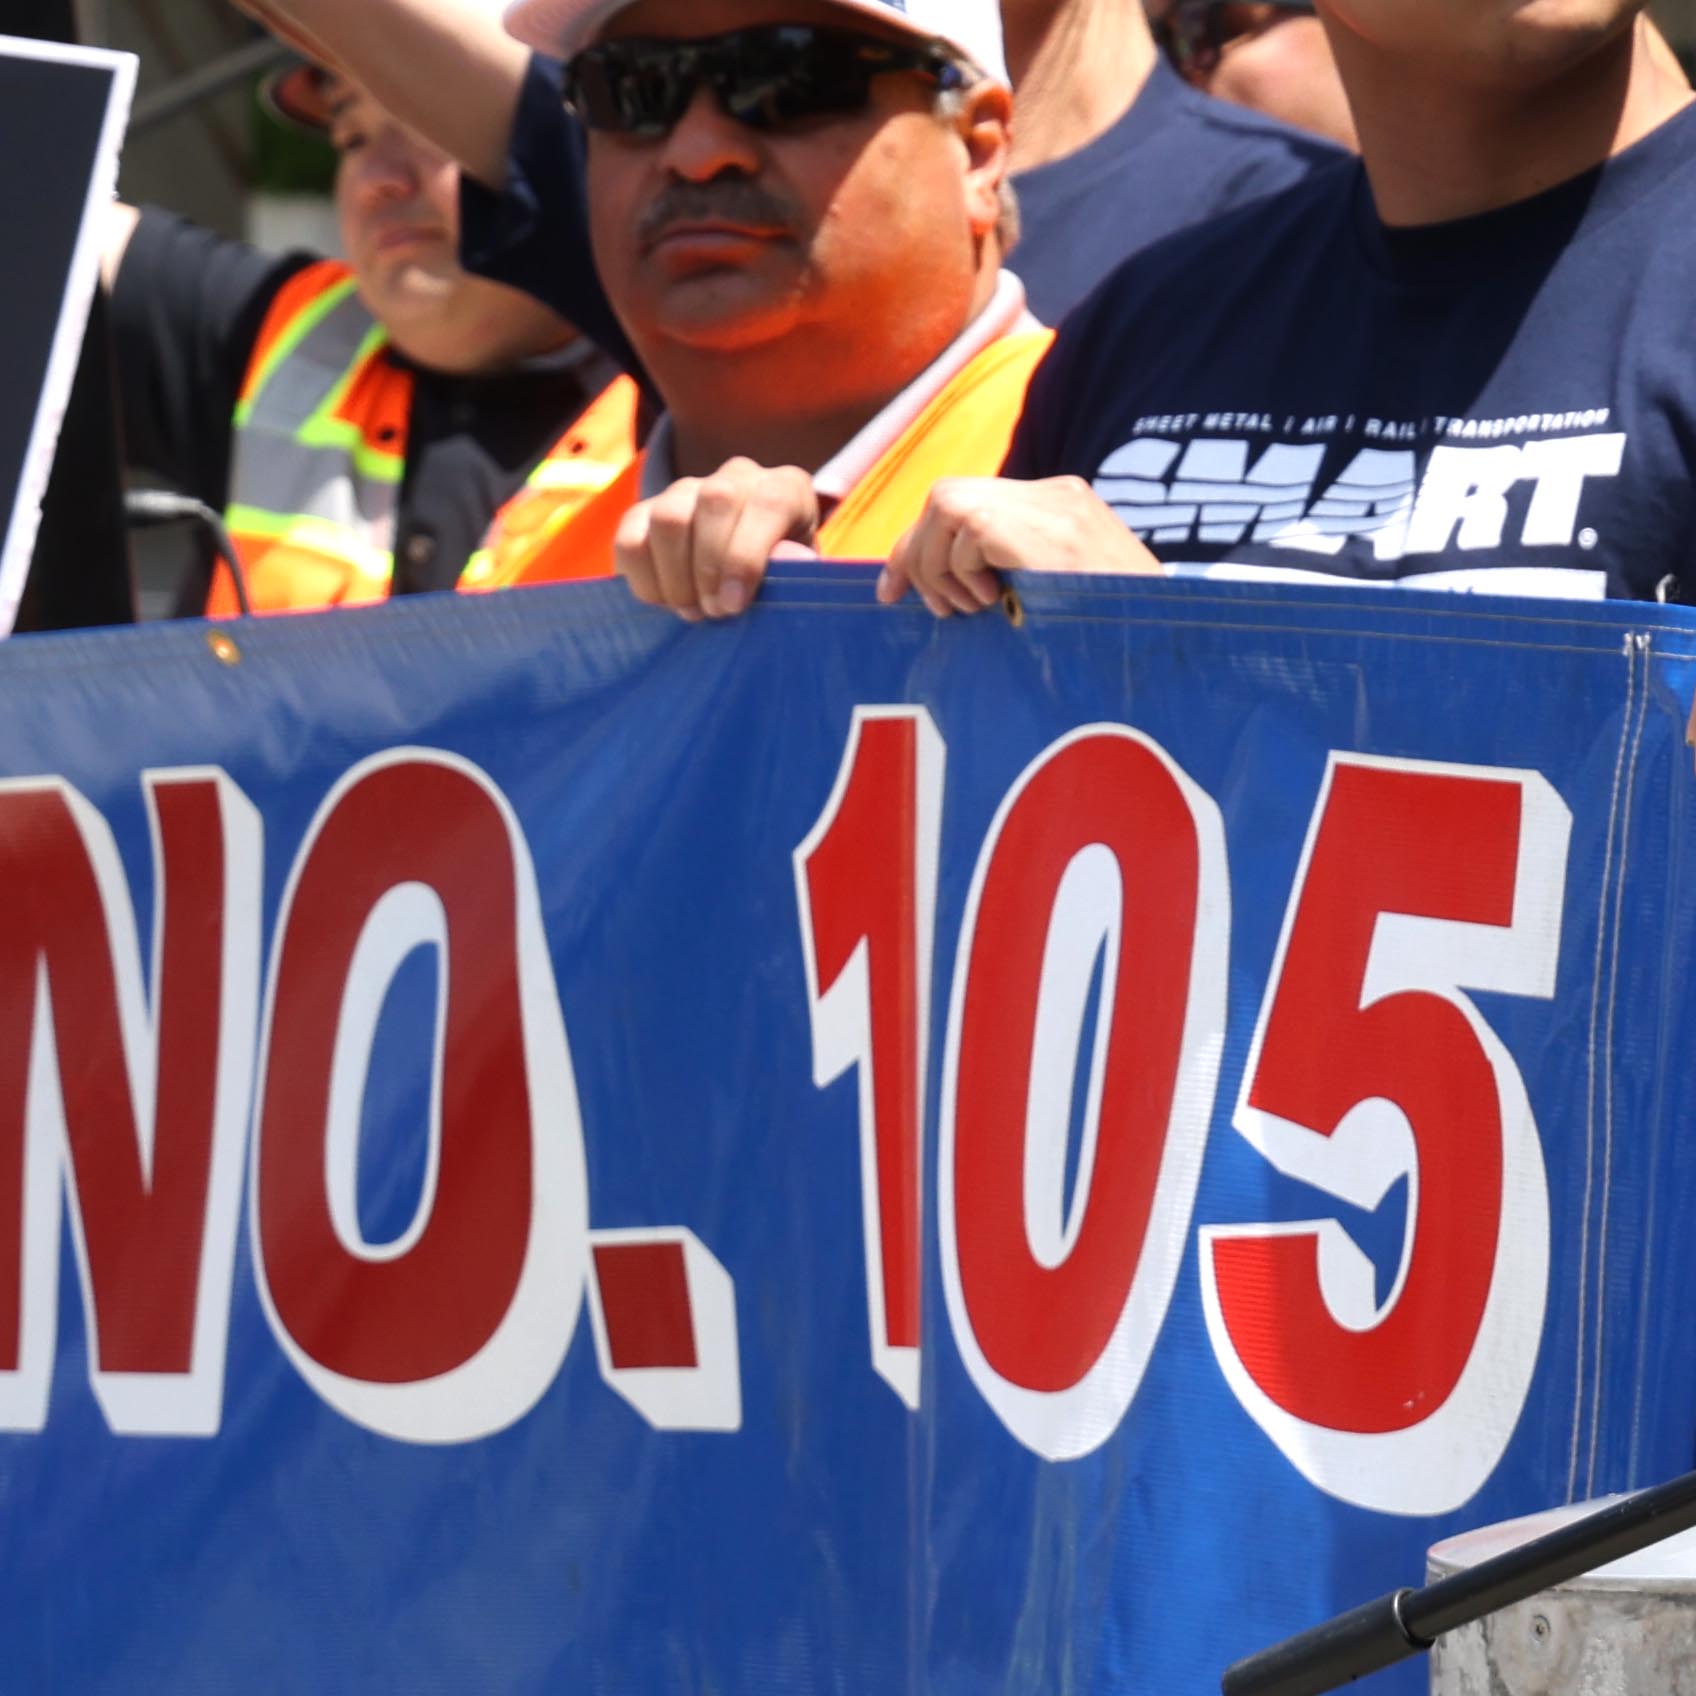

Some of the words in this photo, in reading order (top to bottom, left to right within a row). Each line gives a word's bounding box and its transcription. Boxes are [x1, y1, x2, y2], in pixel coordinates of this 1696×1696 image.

[1132, 412, 1199, 437] SHEET
[1202, 411, 1274, 433] METAL
[1301, 414, 1339, 436] AIR
[1364, 416, 1417, 441] RAIL
[1434, 407, 1611, 440] TRANSPORTATION
[0, 744, 742, 1446] NO.
[792, 702, 1573, 1517] 105
